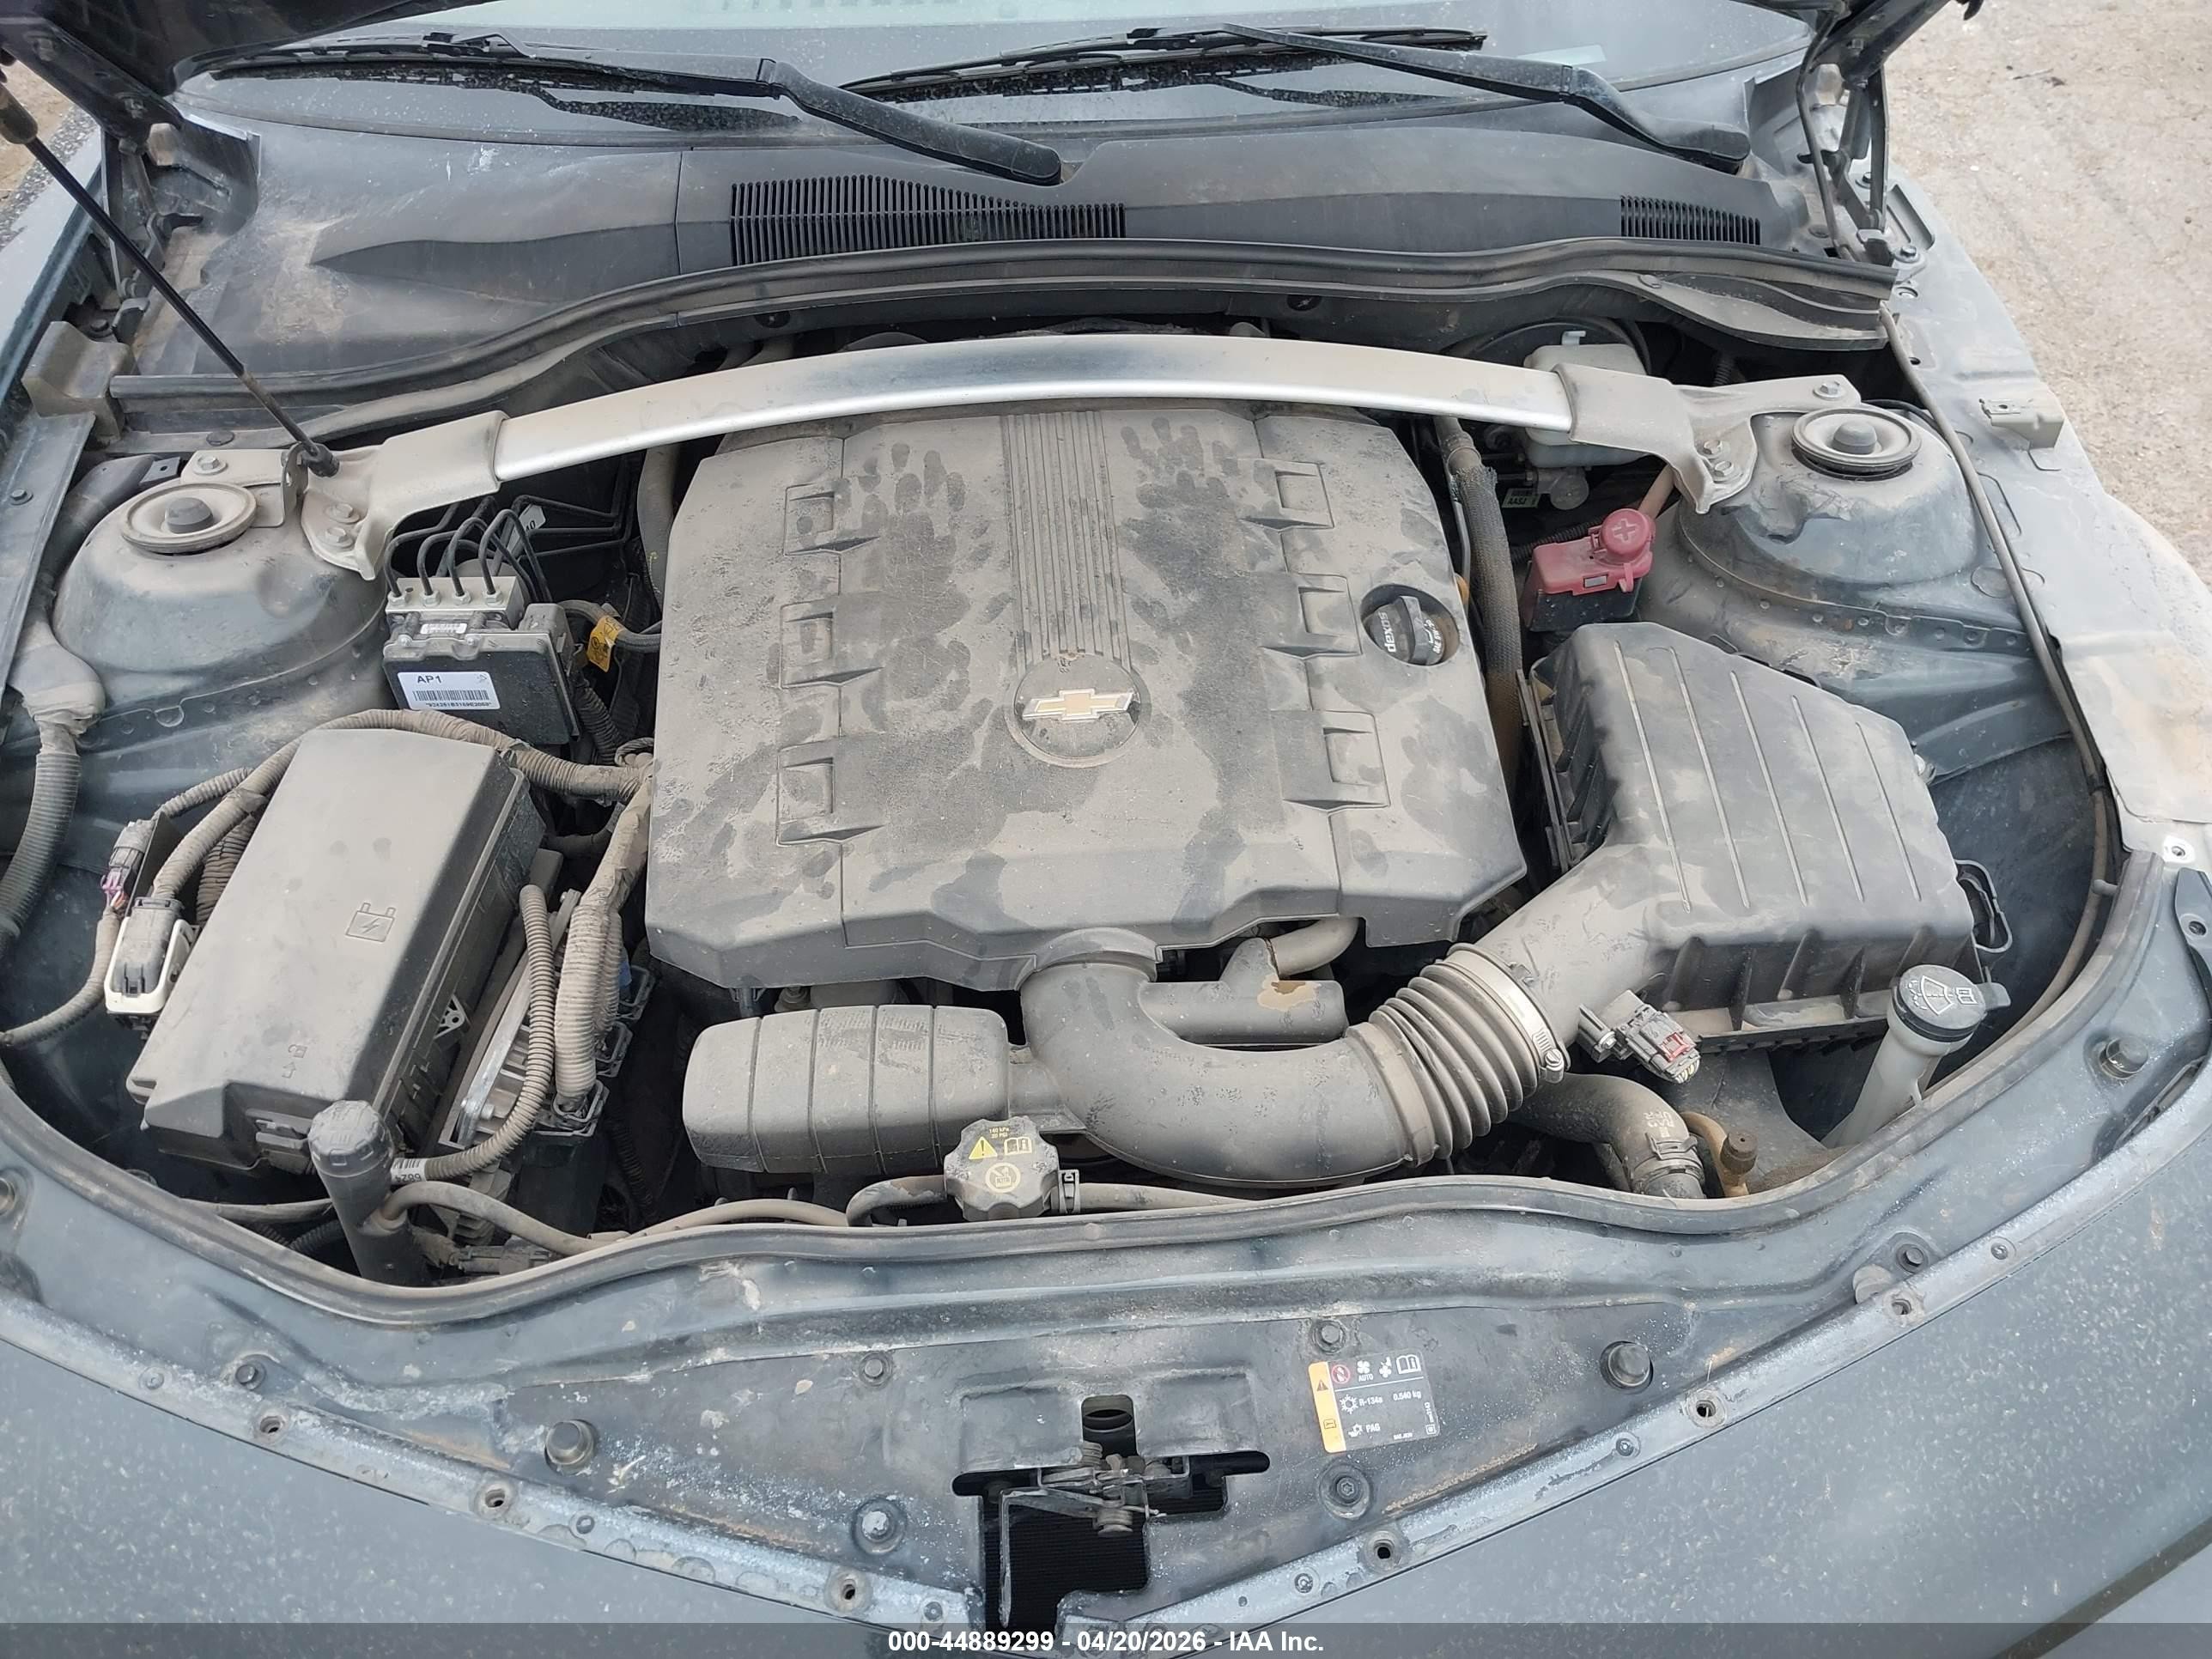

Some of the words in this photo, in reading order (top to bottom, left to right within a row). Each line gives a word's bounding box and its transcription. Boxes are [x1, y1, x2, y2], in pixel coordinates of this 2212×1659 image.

[1378, 611, 1397, 653] dexos
[417, 675, 442, 684] AP1
[1359, 1396, 1383, 1407] R-134a
[1393, 1391, 1411, 1401] 0.540
[1413, 1390, 1422, 1399] kg
[1365, 1423, 1381, 1433] PAG
